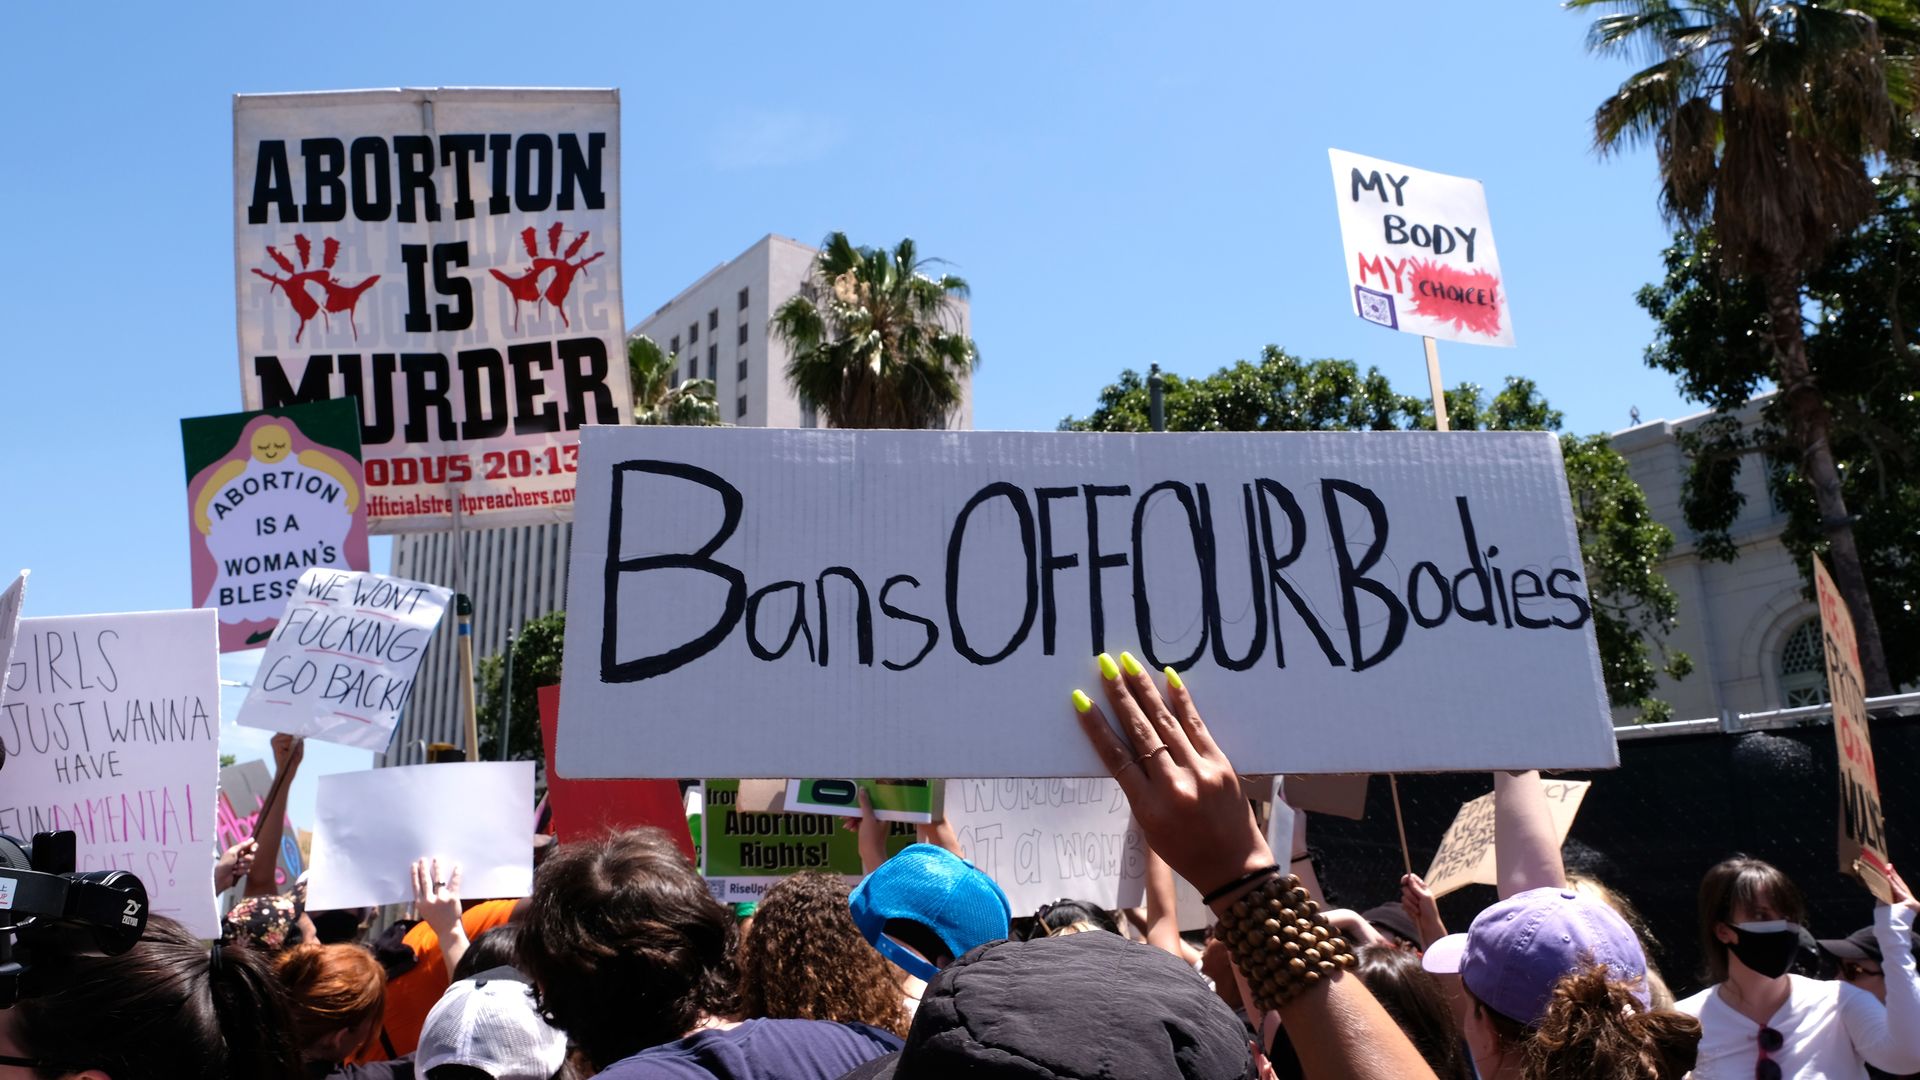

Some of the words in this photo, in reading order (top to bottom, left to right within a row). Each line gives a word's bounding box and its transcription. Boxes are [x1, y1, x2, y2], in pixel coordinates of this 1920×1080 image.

[248, 132, 606, 224] ABORTION
[1351, 167, 1410, 207] MY
[1383, 214, 1477, 263] BODY
[401, 241, 474, 332] IS
[1358, 252, 1408, 294] MY
[1418, 280, 1497, 311] CHOICE!
[365, 453, 472, 487] ODUS
[484, 444, 578, 481] 20:13
[213, 471, 340, 520] ABORTION
[256, 516, 277, 537] IS
[284, 514, 300, 532] A
[225, 540, 337, 578] WOMAN'S
[600, 459, 940, 684] Bans
[1320, 478, 1592, 673] Bodies
[220, 578, 299, 607] BLESS
[308, 573, 349, 602] WE
[353, 579, 430, 615] WONT
[276, 608, 421, 663] FUCKING
[263, 655, 318, 696] GO
[319, 663, 411, 720] BACK!
[2, 701, 90, 757] JUST
[103, 695, 212, 745] WANNA
[54, 750, 123, 785] HAVE
[724, 811, 836, 837] Abortion
[740, 842, 830, 870] Rights!
[957, 824, 1003, 885] OT
[1053, 829, 1147, 881] WOMB
